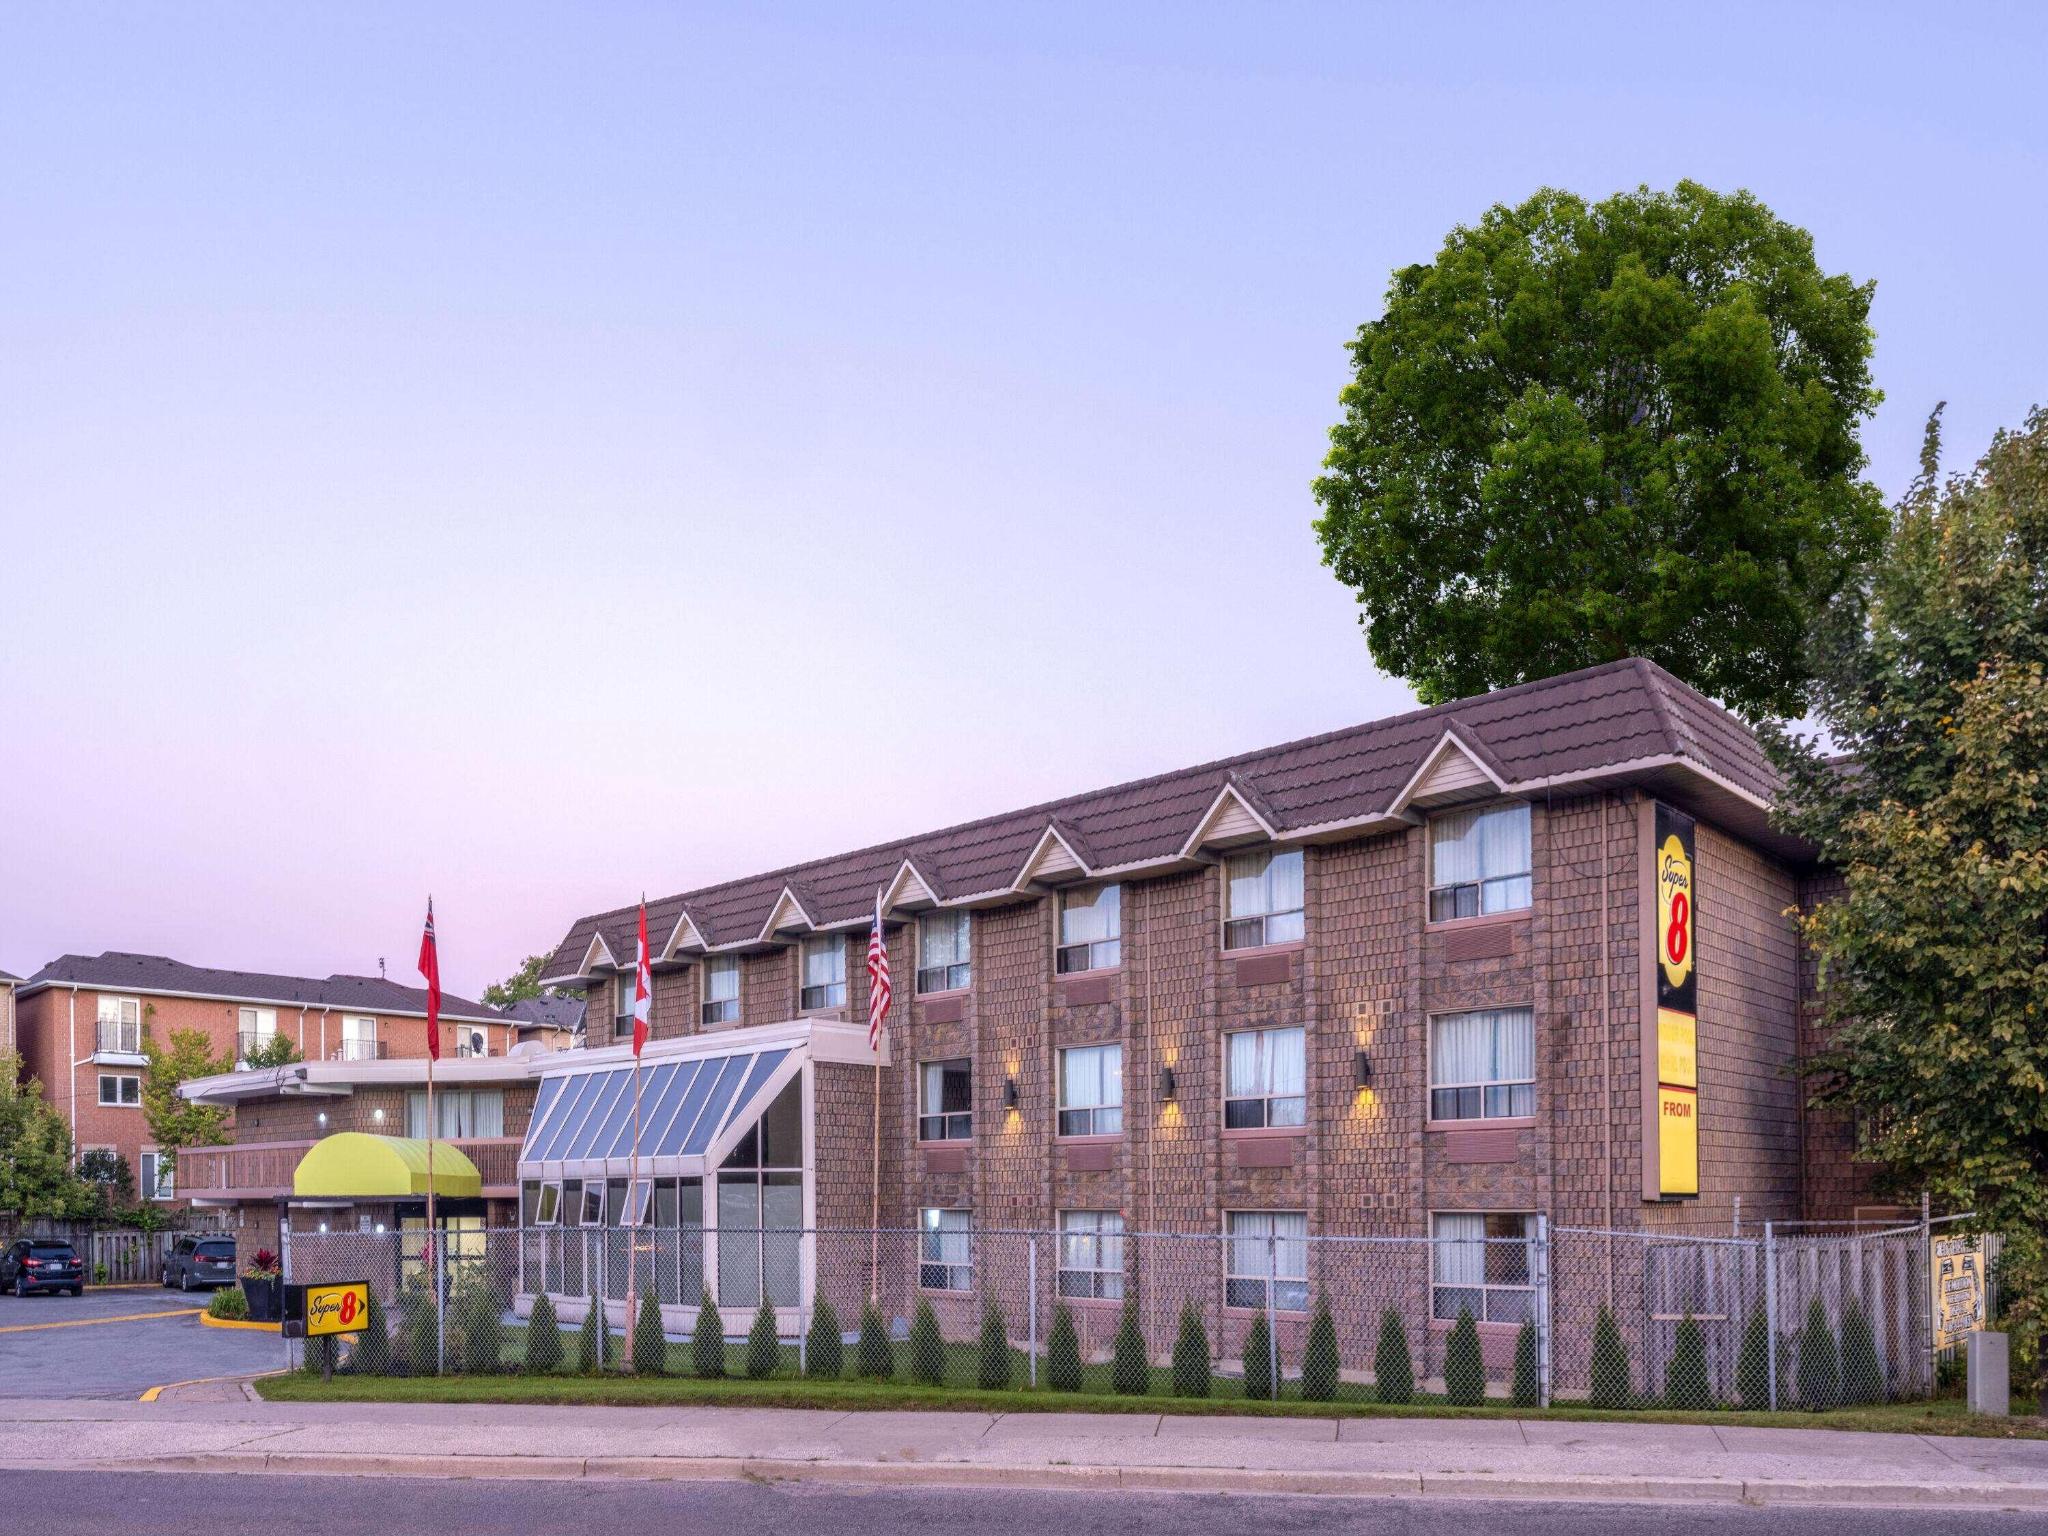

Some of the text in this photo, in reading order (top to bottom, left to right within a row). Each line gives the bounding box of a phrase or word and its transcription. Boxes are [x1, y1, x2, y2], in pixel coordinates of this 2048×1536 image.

[1662, 854, 1688, 898] Super
[1667, 892, 1688, 964] 8
[1663, 1101, 1692, 1118] FROM
[310, 1291, 357, 1325] Super 8
